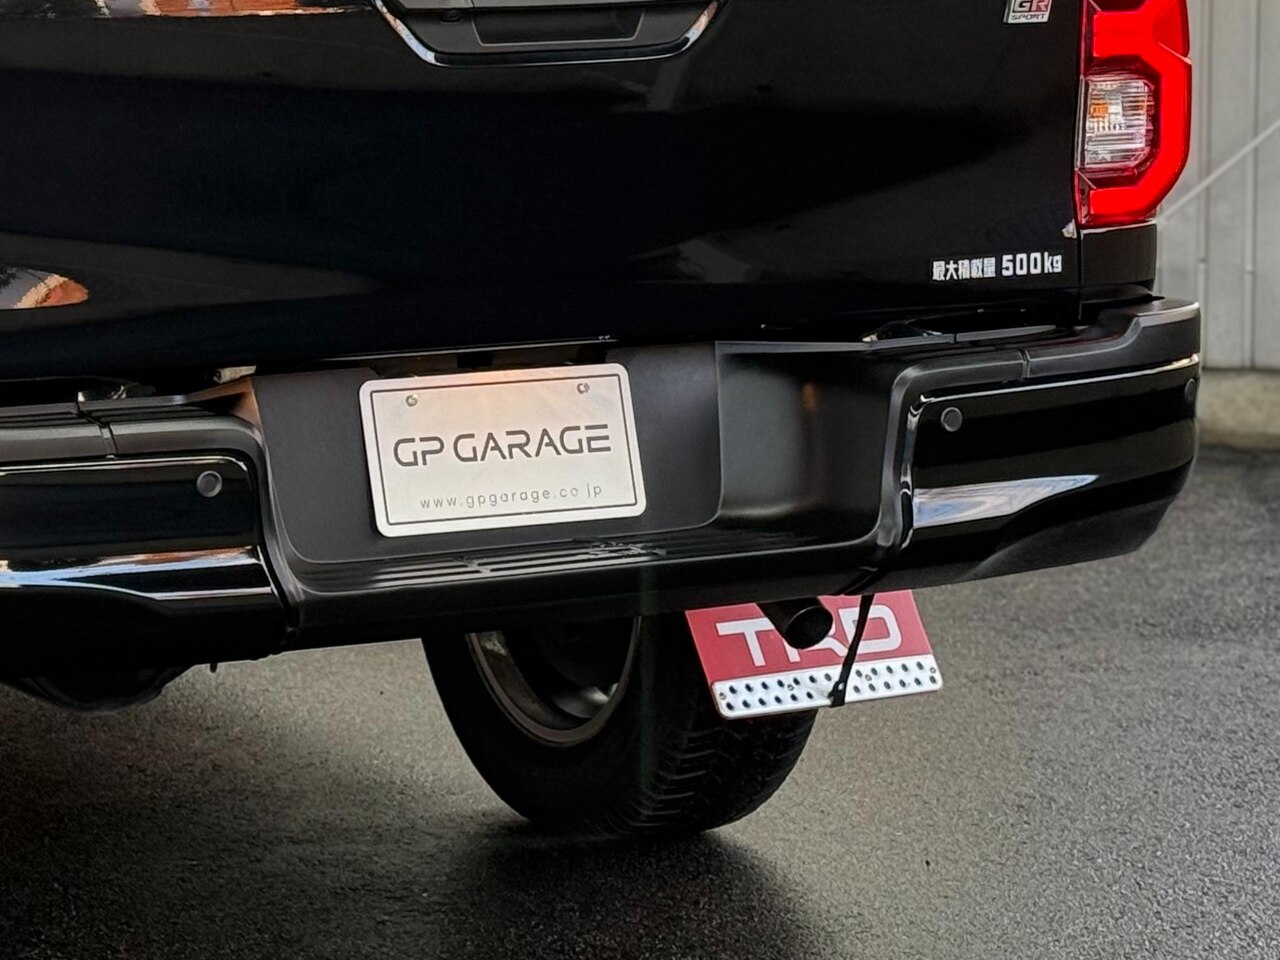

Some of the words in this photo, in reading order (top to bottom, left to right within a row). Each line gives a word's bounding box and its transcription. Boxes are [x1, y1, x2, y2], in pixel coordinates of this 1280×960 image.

[1010, 13, 1046, 21] SPORT
[1002, 252, 1062, 276] 500kg
[394, 436, 444, 467] GP
[453, 424, 611, 462] GARAGE
[420, 483, 603, 509] www.gpgarage.cojp
